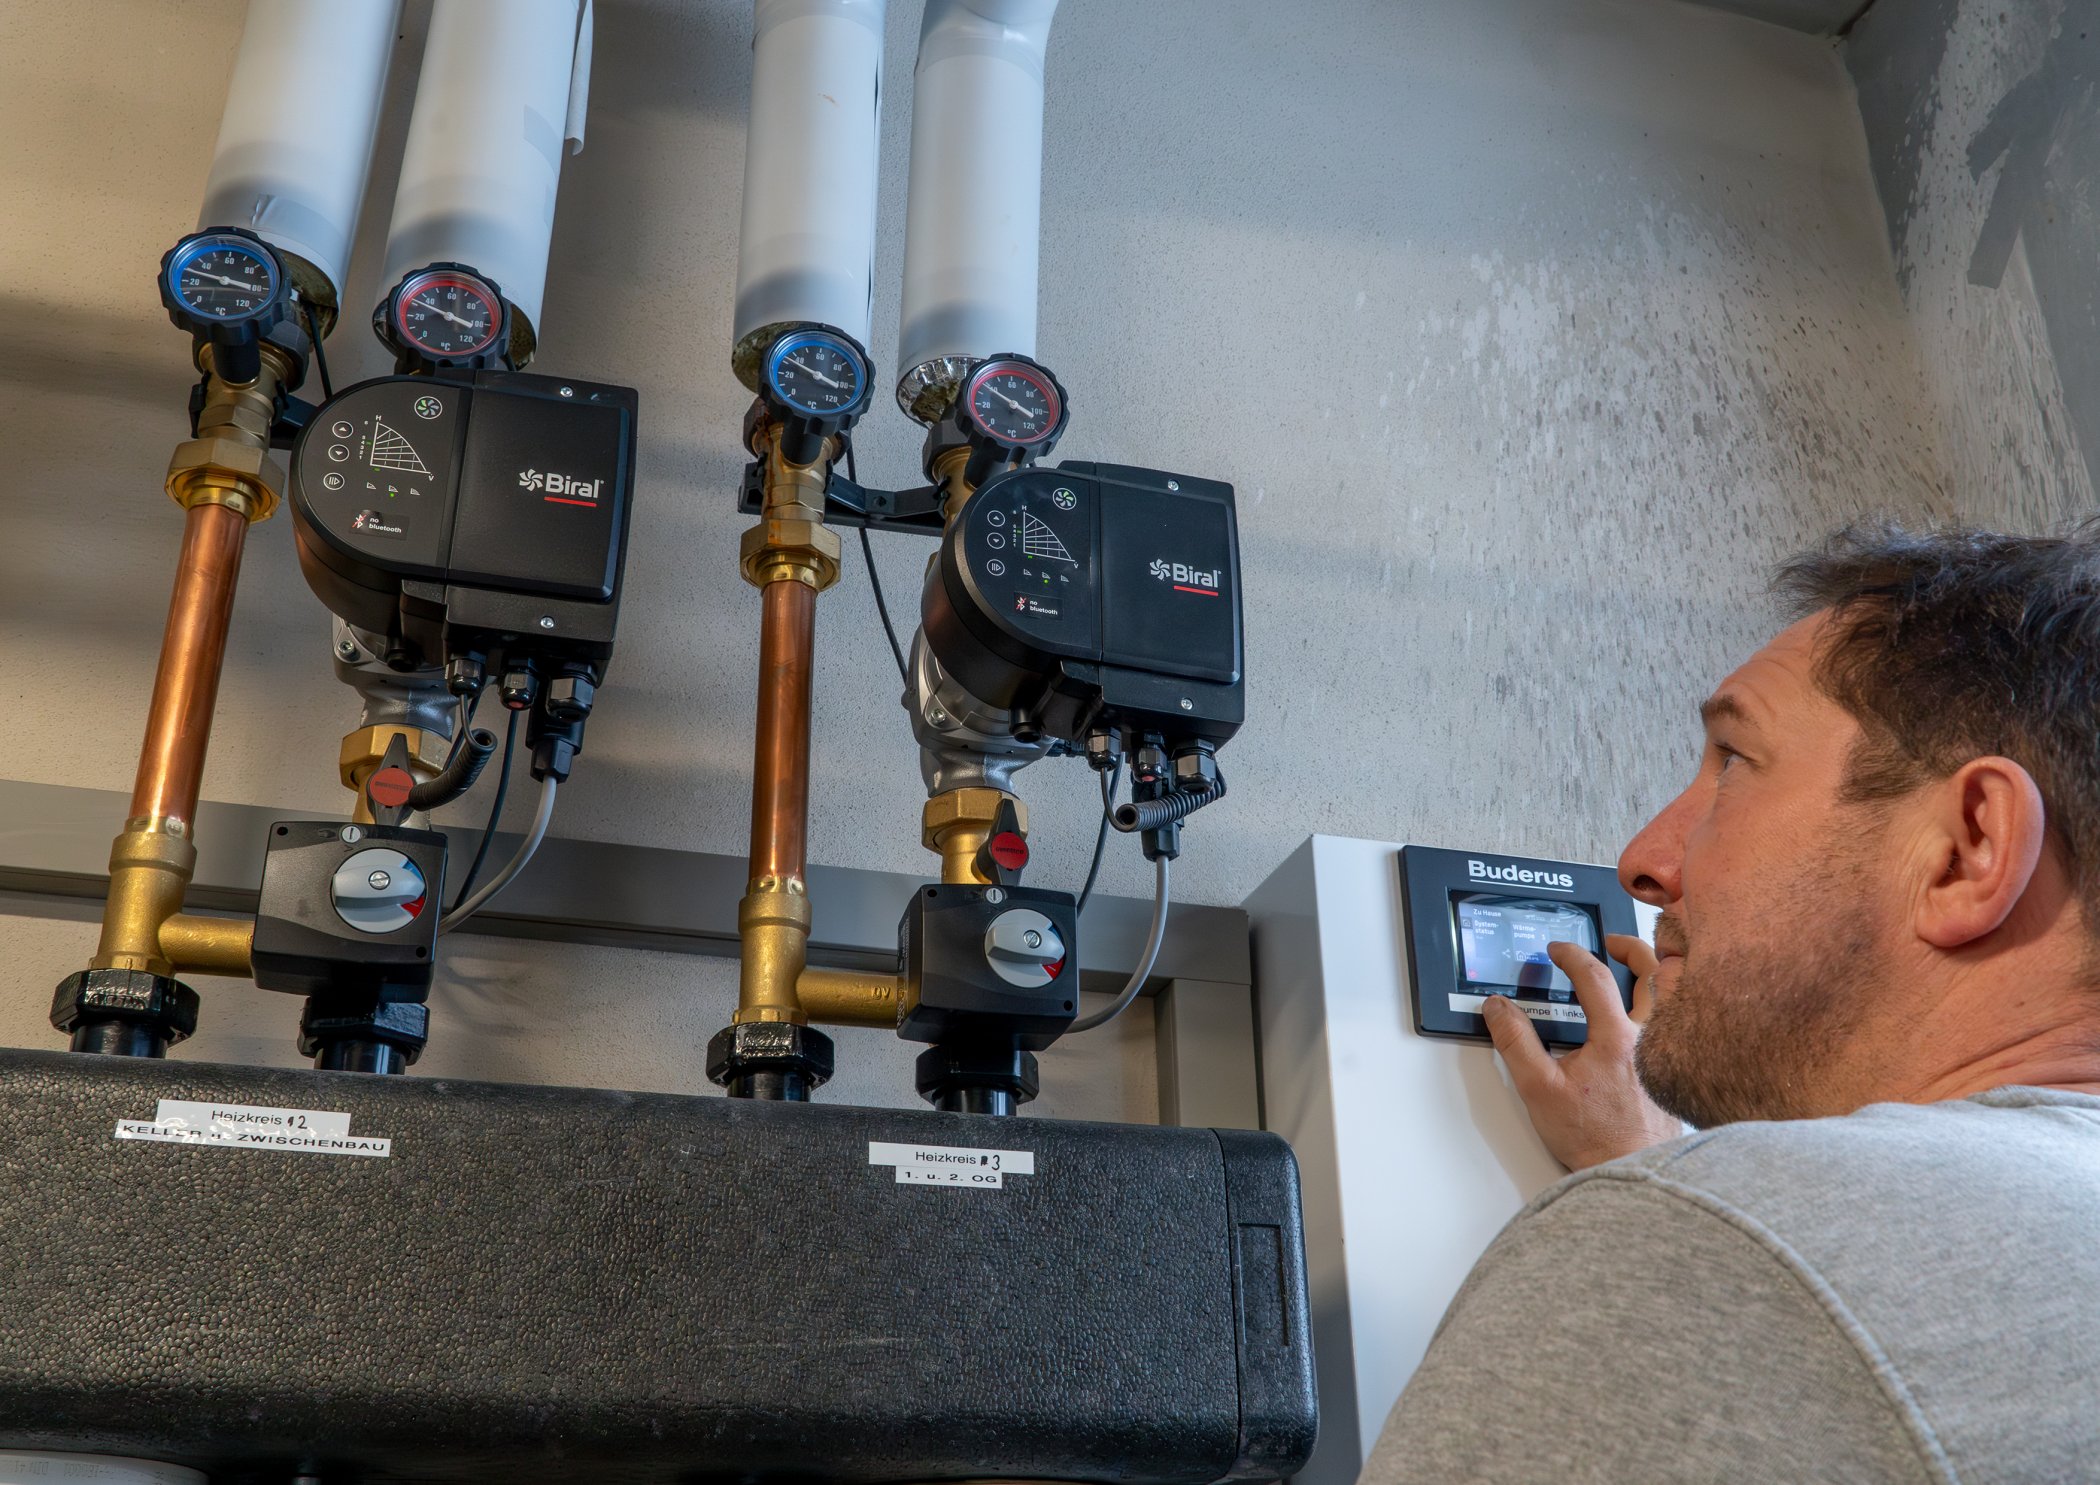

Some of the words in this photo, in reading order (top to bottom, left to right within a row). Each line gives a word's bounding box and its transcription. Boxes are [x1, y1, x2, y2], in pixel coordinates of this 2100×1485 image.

[224, 257, 235, 265] 60
[201, 262, 212, 270] 40
[244, 266, 255, 275] 80
[189, 278, 200, 286] 20
[196, 295, 202, 303] 0
[235, 299, 250, 307] 120
[466, 302, 476, 310] 80
[215, 307, 226, 316] °C
[414, 313, 425, 321] 20
[459, 334, 473, 343] 120
[440, 342, 451, 351] °C
[815, 352, 825, 360] 60
[833, 363, 842, 371] 80
[784, 371, 794, 379] 20
[1007, 381, 1017, 389] 60
[791, 388, 796, 396] 0
[1025, 390, 1035, 398] 80
[825, 394, 838, 403] 120
[807, 401, 817, 410] °C
[982, 401, 991, 409] 20
[1030, 407, 1043, 415] 100
[1023, 421, 1035, 430] 120
[1007, 429, 1017, 438] °C
[545, 472, 600, 499] Biral
[368, 523, 402, 534] bluetooth
[1172, 562, 1219, 588] Biral
[1029, 605, 1058, 616] bluetooth
[1468, 859, 1574, 888] Buderus
[1473, 908, 1482, 916] Zu
[1483, 910, 1502, 918] Hause
[1475, 928, 1495, 936] status
[1514, 932, 1536, 941] pumpe
[1554, 1008, 1559, 1016] 1
[1562, 1009, 1585, 1019] links
[211, 1110, 282, 1126] Heizkreis
[297, 1114, 308, 1130] 2
[237, 1133, 385, 1152] ZWISCHENBAU
[915, 1151, 977, 1165] Heizkreis
[991, 1154, 1001, 1171] 3
[904, 1171, 919, 1179] 1.
[949, 1173, 965, 1182] 2.
[972, 1174, 997, 1183] OG
